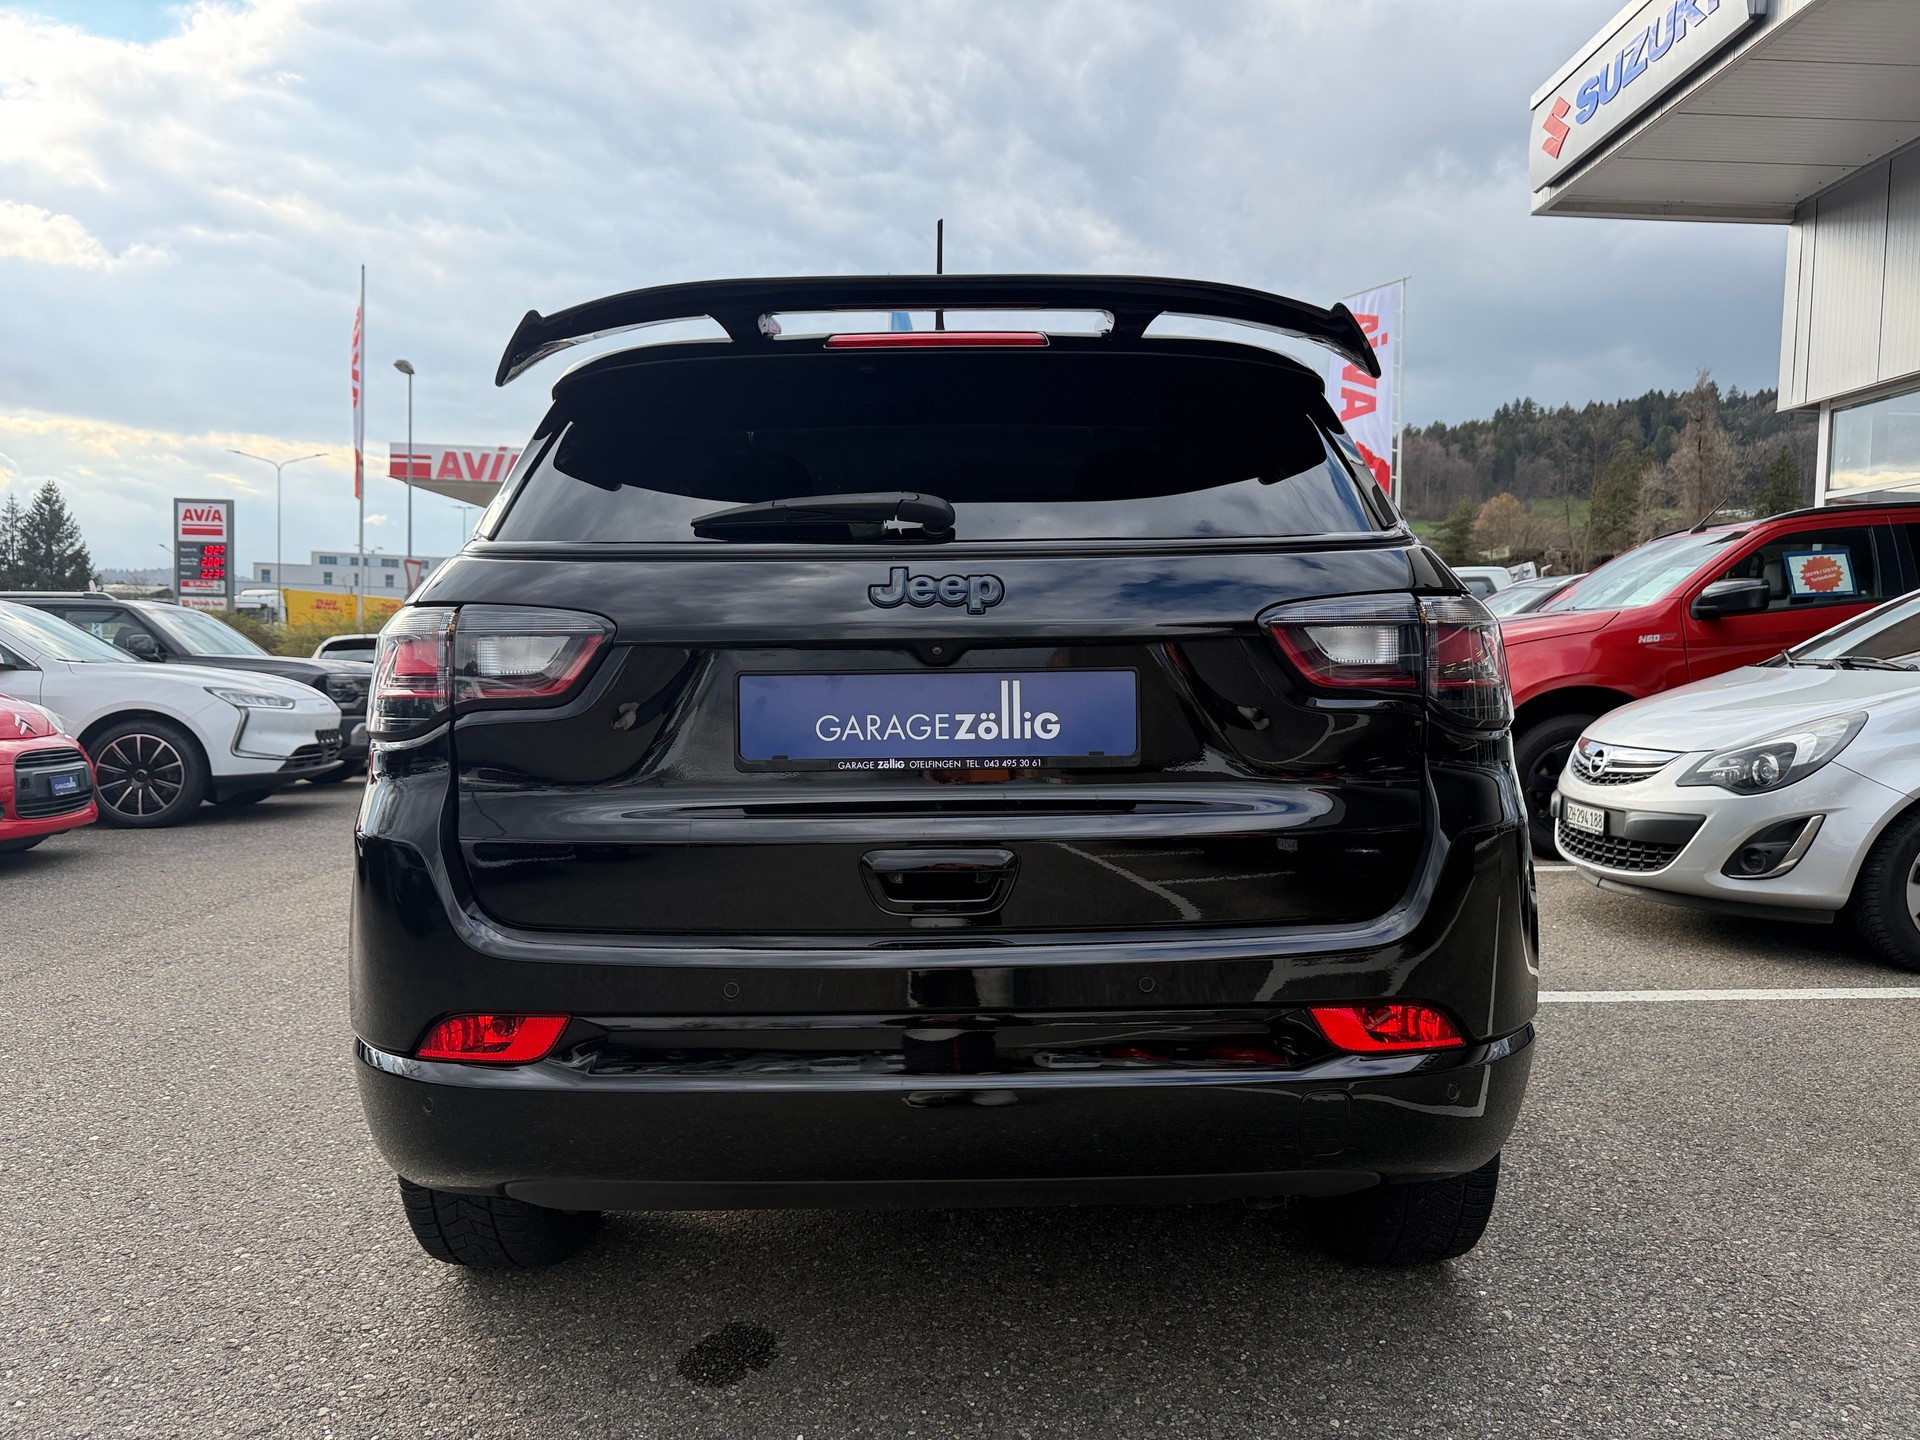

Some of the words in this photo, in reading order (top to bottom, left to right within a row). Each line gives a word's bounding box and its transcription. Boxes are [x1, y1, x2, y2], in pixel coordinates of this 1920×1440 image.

[436, 446, 520, 481] AVI
[182, 506, 223, 522] AVIA
[869, 567, 1004, 615] Jeep
[815, 713, 950, 742] GARAGE
[837, 760, 874, 770] GARAGE
[909, 759, 961, 769] OTELFINGEN
[984, 759, 1000, 768] 043
[1002, 758, 1017, 768] 495
[1019, 758, 1030, 767] 30
[1031, 758, 1042, 767] 61
